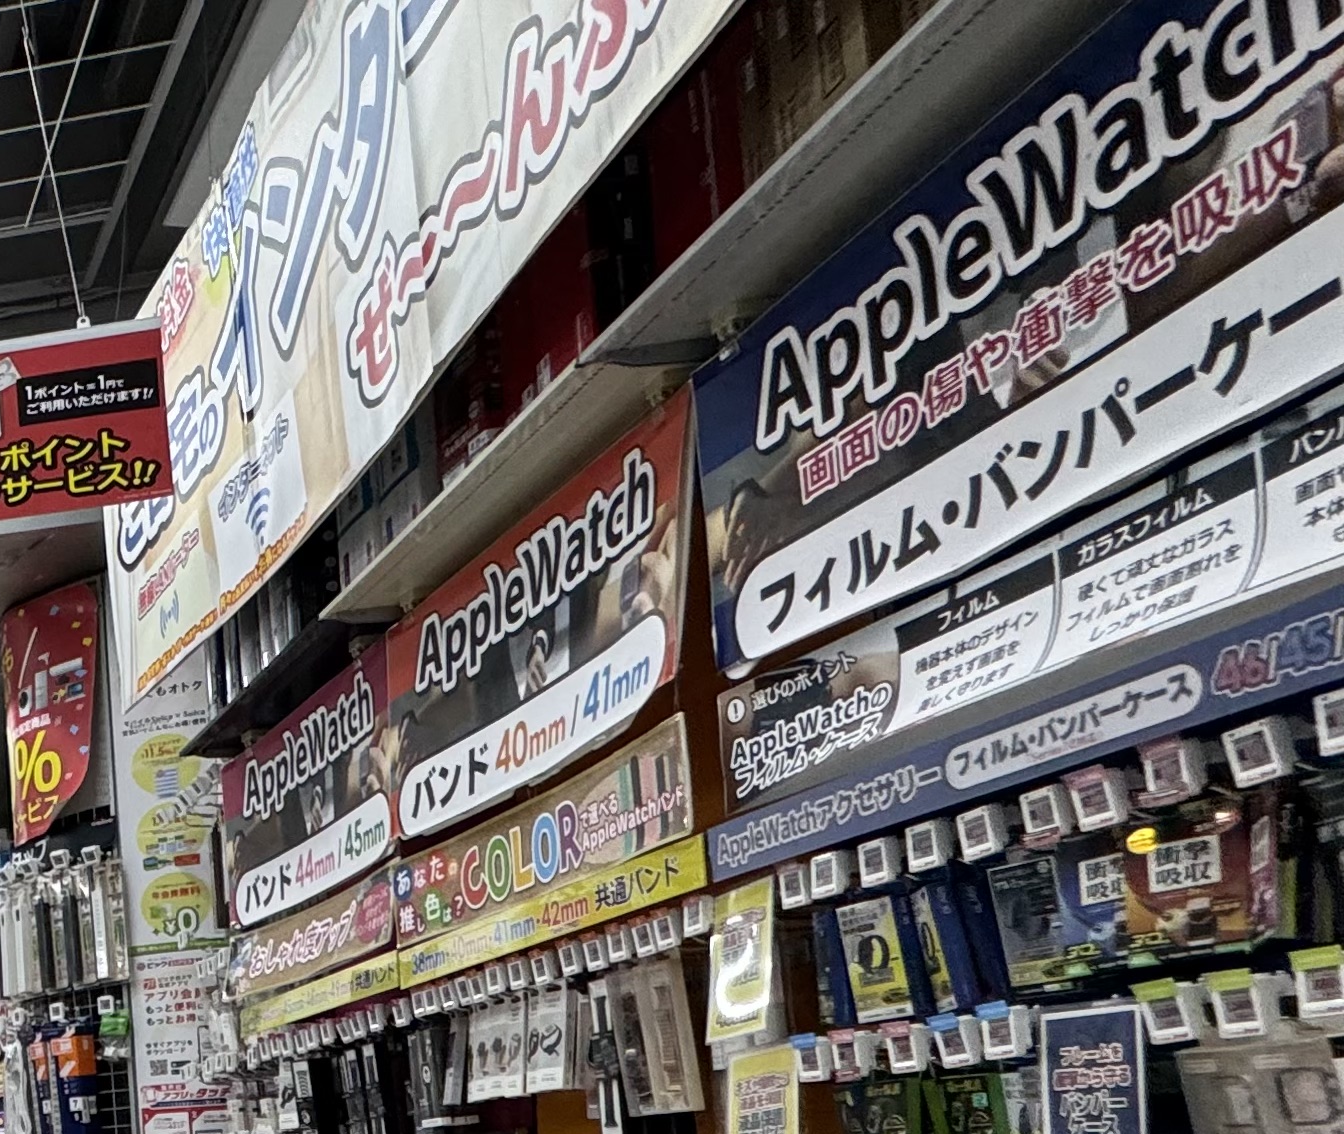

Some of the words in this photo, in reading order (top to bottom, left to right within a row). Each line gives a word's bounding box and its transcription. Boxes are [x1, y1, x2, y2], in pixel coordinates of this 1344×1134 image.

[797, 122, 1308, 504] 画面の傷や衝撃を吸収
[1, 433, 128, 472] ポイント
[414, 448, 656, 695] AppleWatch
[1077, 487, 1215, 567] ガラスフィルム
[938, 590, 1001, 632] フィルム
[242, 671, 374, 821] AppleWatch
[412, 742, 488, 820] バンド
[494, 720, 567, 770] 40mm
[582, 653, 652, 722] 41mm
[717, 764, 943, 868] AppleWatchアクセサリー
[953, 671, 1195, 779] フィルム・バンパーケース
[730, 683, 893, 769] AppleWatchの
[245, 870, 292, 913] バンド
[294, 846, 337, 888] 44mm
[343, 821, 387, 860] 45mm
[460, 800, 583, 909] COLOR
[595, 855, 680, 908] 共通バンド
